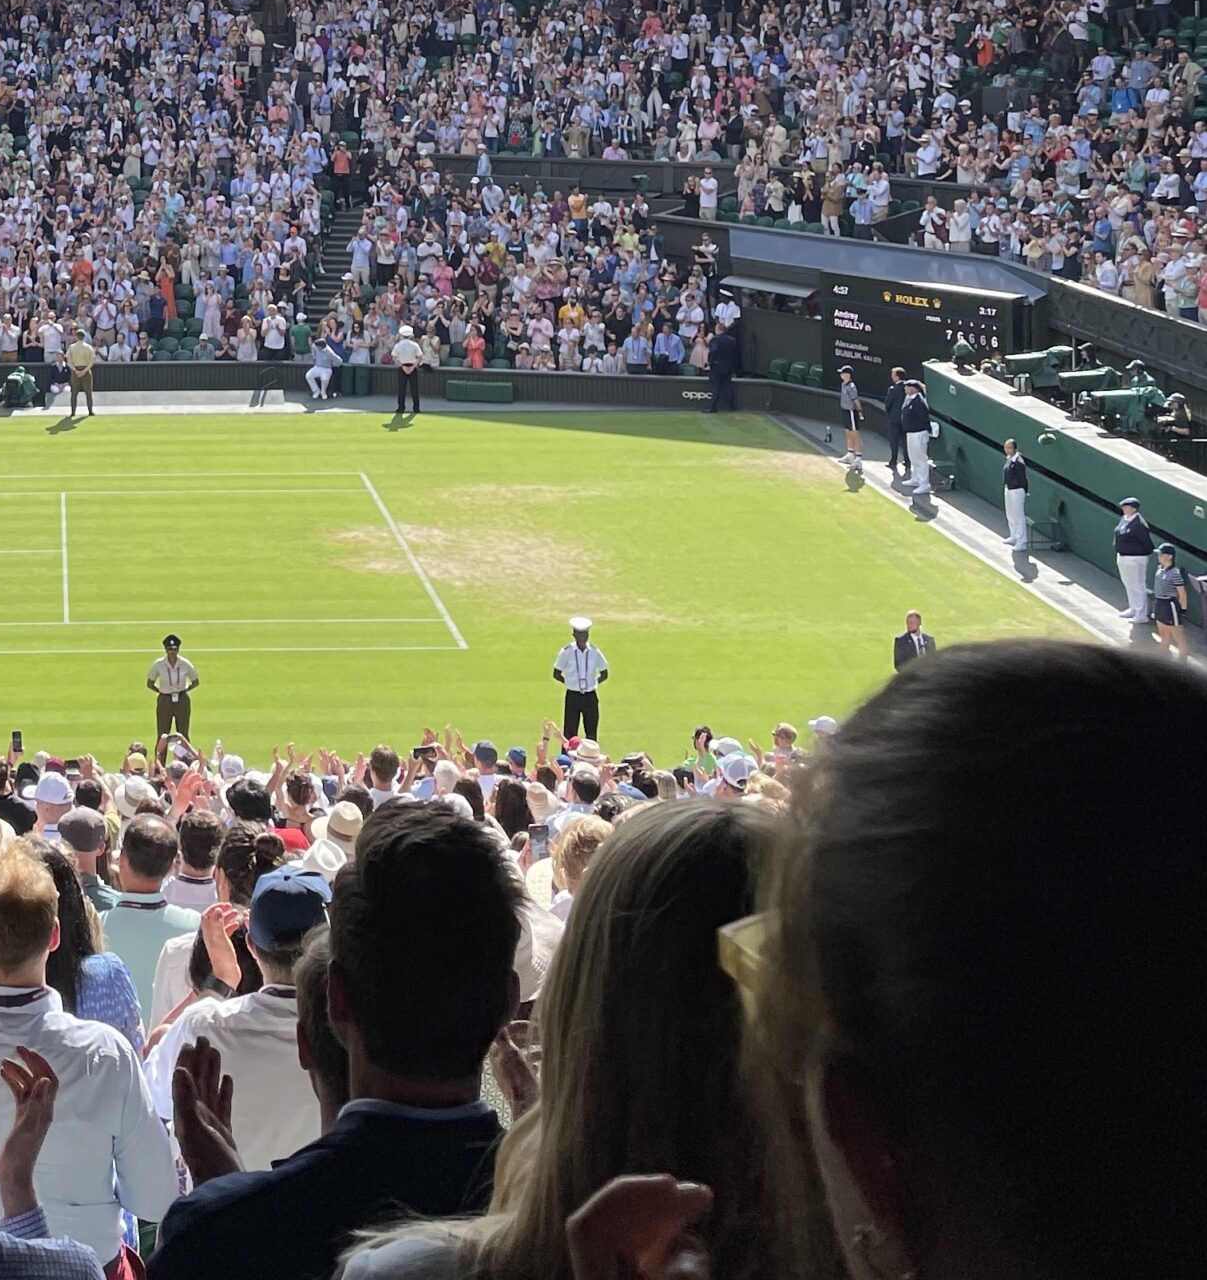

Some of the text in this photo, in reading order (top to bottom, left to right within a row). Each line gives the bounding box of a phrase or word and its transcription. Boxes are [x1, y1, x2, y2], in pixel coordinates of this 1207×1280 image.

[895, 294, 929, 307] ROLEX
[946, 329, 953, 341] 7
[956, 331, 964, 341] 6
[968, 333, 975, 344] 6
[979, 335, 987, 346] 6
[991, 336, 999, 348] 6
